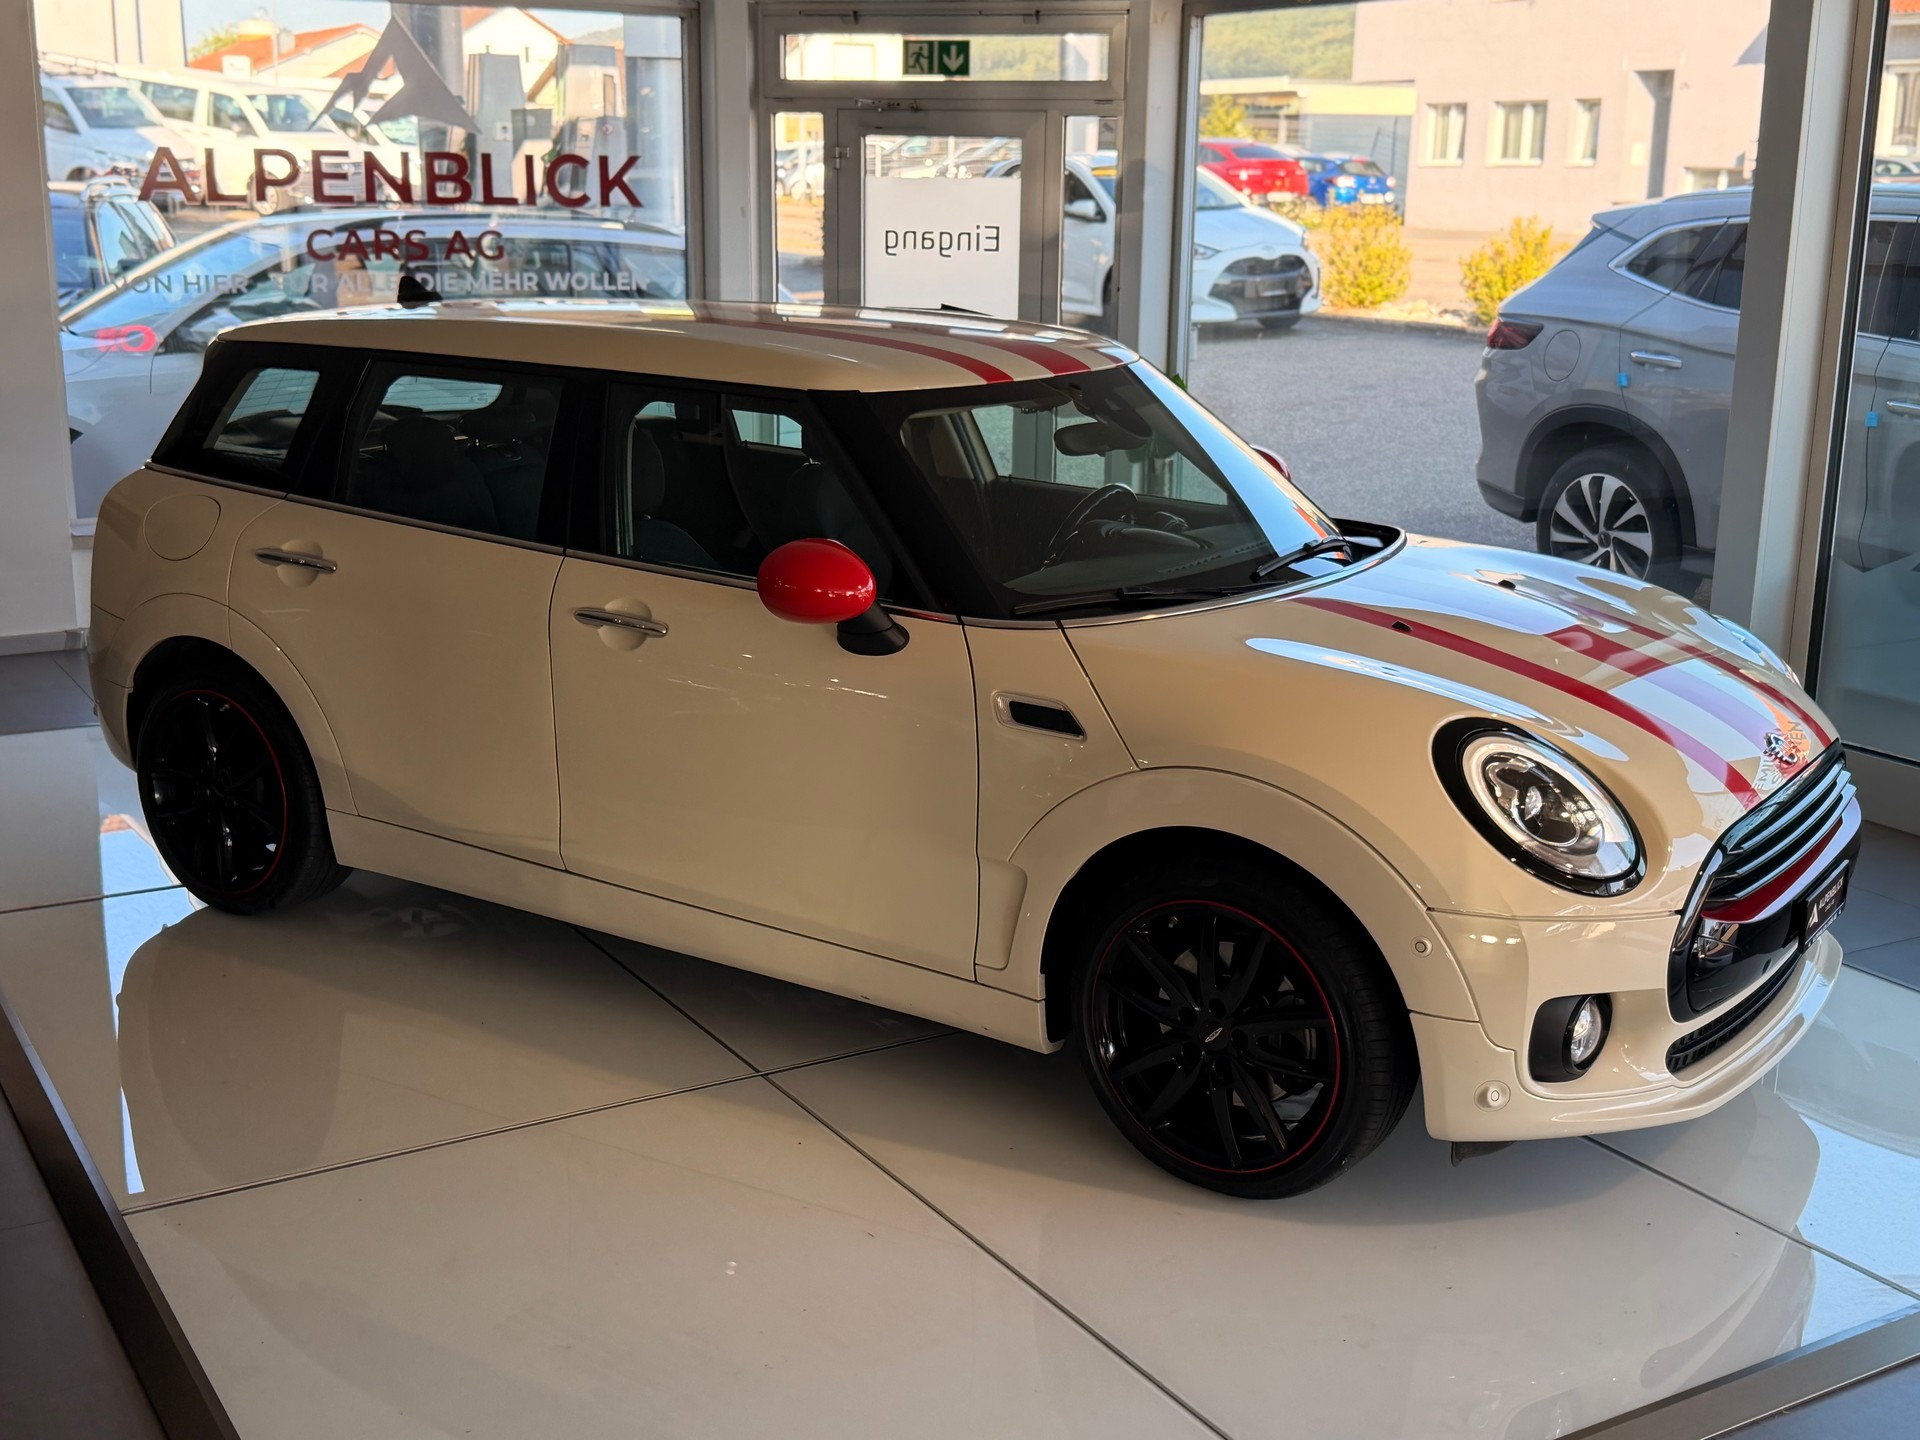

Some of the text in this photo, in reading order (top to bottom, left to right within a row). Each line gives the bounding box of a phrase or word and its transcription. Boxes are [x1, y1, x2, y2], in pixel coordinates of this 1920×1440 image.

[138, 146, 644, 208] ALPENBLICK
[306, 228, 505, 262] CARS AG
[112, 274, 172, 294] VON
[183, 273, 250, 295] HIER
[415, 271, 459, 292] DIE
[466, 272, 540, 292] MEHR
[544, 271, 650, 292] WOLLEN
